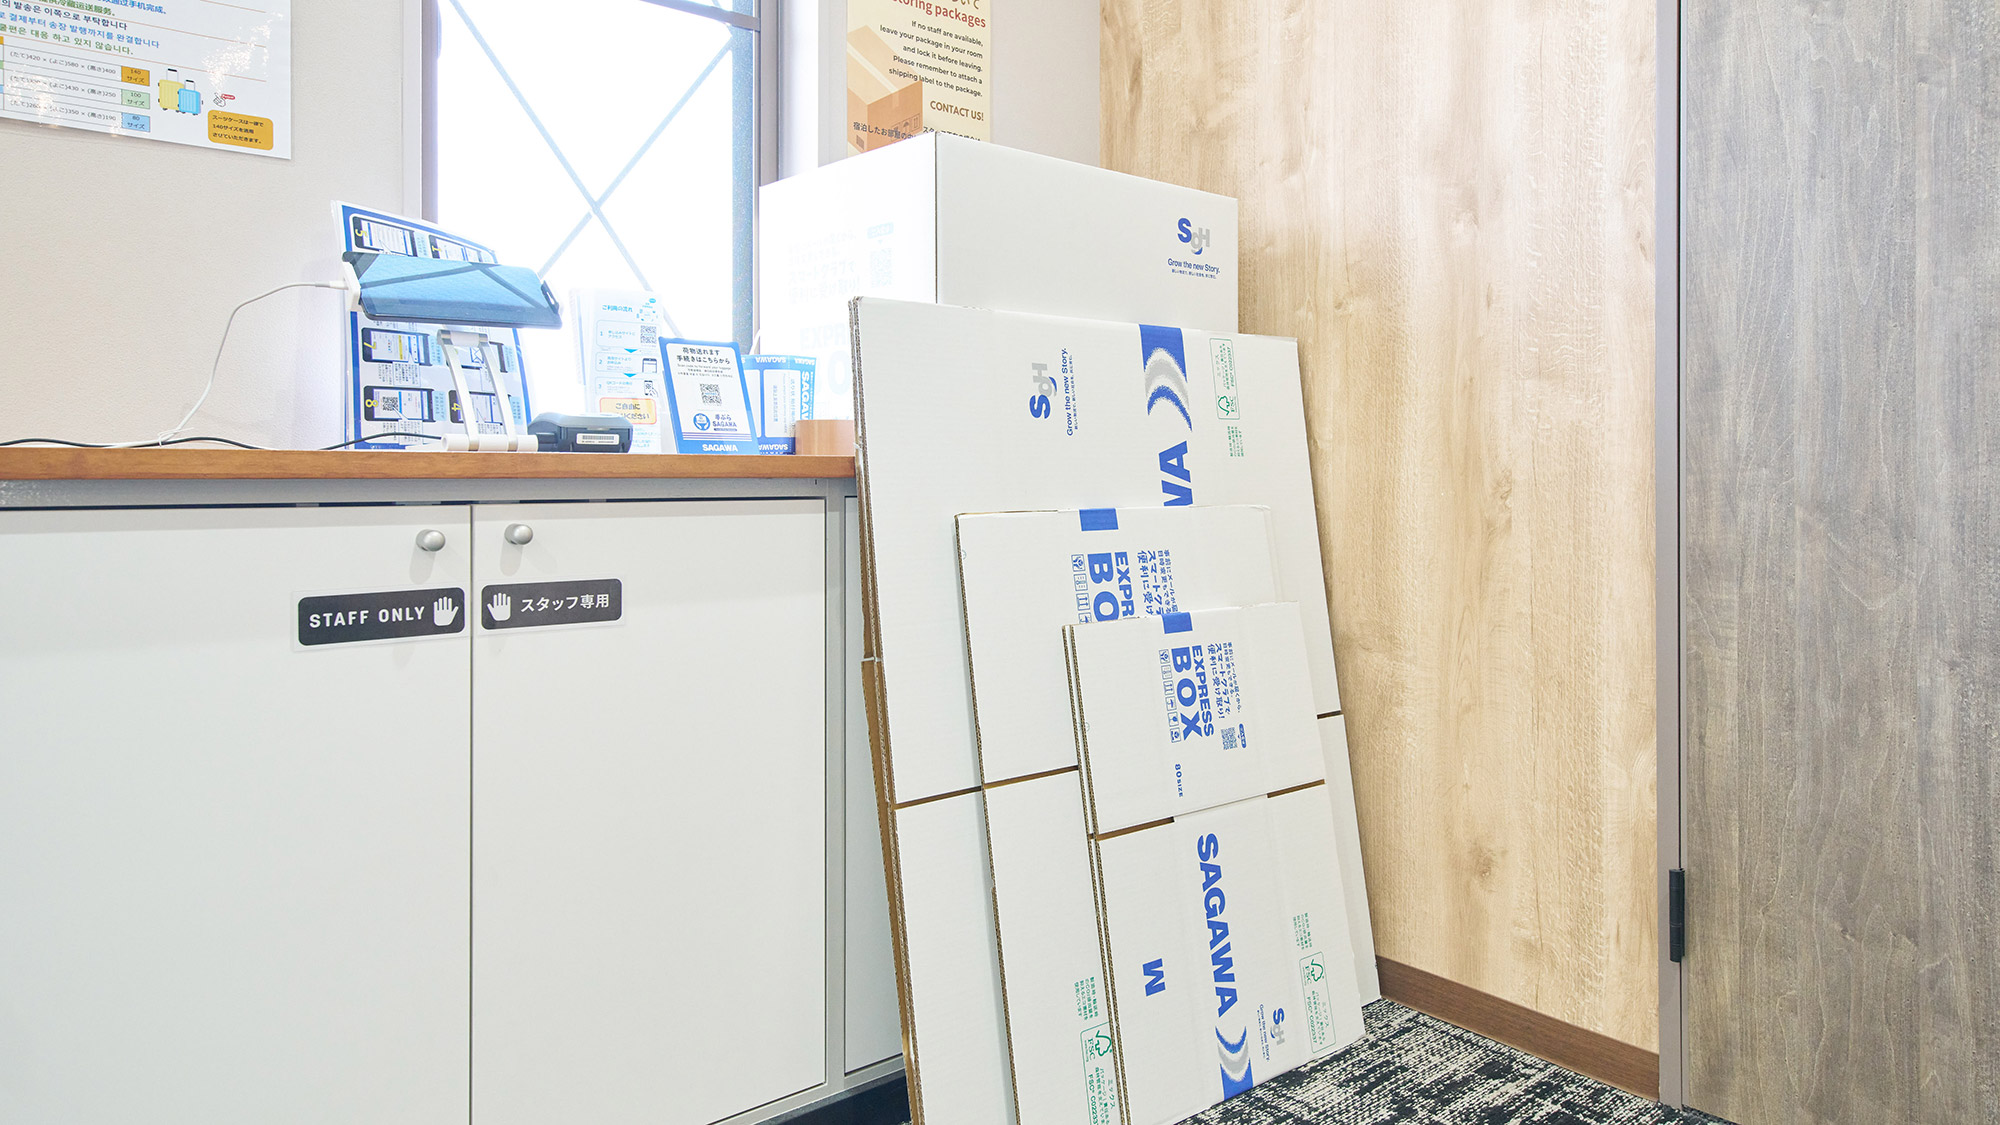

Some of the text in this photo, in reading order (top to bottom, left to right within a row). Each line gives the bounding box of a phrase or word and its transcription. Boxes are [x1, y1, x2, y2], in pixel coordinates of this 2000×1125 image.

[83, 15, 127, 30] 부탁합니다
[935, 5, 986, 28] packages
[880, 25, 983, 59] leave your package in your room
[927, 26, 942, 34] staff
[942, 30, 954, 39] are
[893, 54, 915, 67] please
[916, 62, 949, 76] remember
[950, 70, 958, 78] to
[958, 72, 978, 84] attach
[903, 45, 983, 72] and lock it before leaving.
[889, 67, 983, 97] shipping label to the package.
[930, 100, 985, 122] CONTACT US!
[1167, 257, 1183, 268] Grow
[1183, 261, 1193, 270] the
[1192, 263, 1204, 271] new
[1204, 264, 1221, 275] Story.
[1061, 347, 1069, 374] Story.
[365, 398, 378, 407] 8
[1066, 412, 1074, 436] Grow
[702, 443, 739, 452] SAGAWA
[1137, 550, 1154, 616] 便利に受け
[520, 593, 610, 614] スタッフ専用
[309, 606, 426, 629] STAFF ONLY
[1191, 644, 1215, 737] EXPRESS
[1215, 643, 1232, 715] スマートクラブで
[1171, 646, 1204, 741] BOX
[1196, 832, 1239, 1019] SAGAWA
[1088, 1038, 1096, 1061] FSC
[1090, 1095, 1099, 1125] C02233
